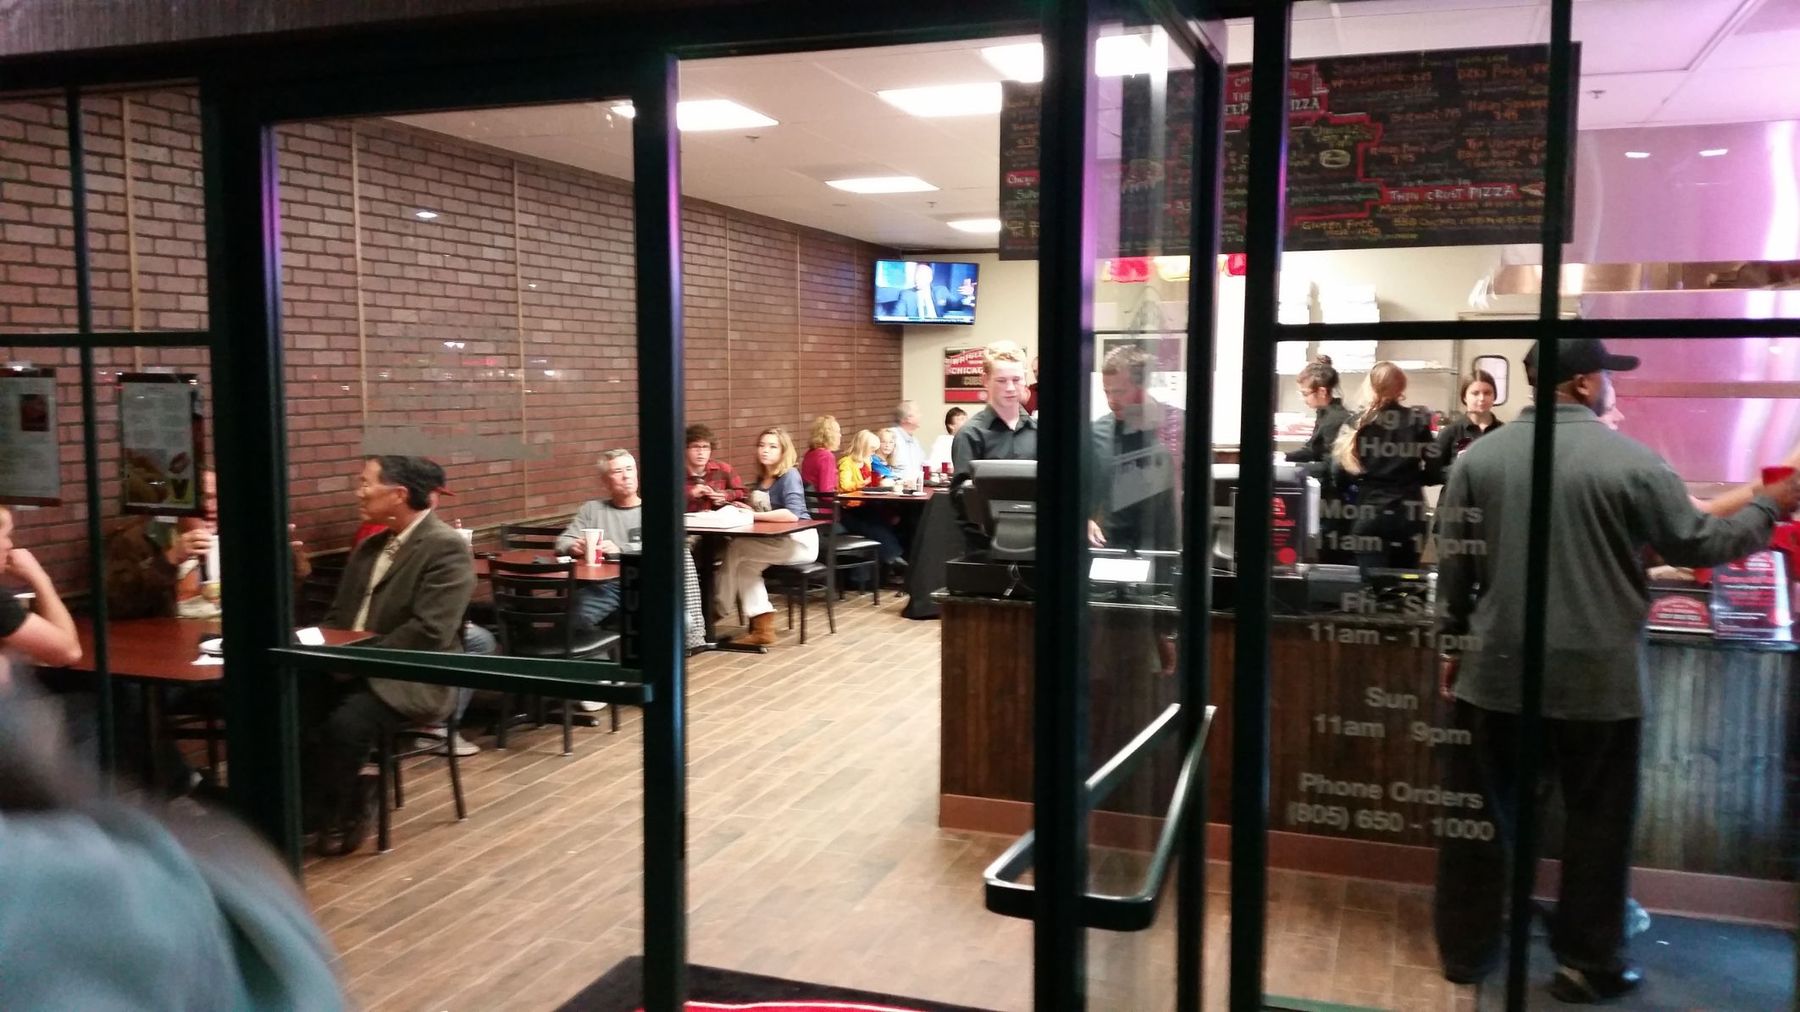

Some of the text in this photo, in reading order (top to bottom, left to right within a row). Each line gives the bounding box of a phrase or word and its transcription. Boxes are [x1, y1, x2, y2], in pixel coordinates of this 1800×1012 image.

[1468, 184, 1516, 199] PIZZA
[1360, 436, 1442, 458] Hours
[1319, 498, 1376, 520] Mon
[1308, 621, 1380, 645] 11am
[1408, 626, 1484, 654] 11pm
[1365, 686, 1419, 710] Sun
[1313, 713, 1472, 747] 11am 9pm
[1298, 772, 1484, 810] Phone Orders
[1354, 808, 1404, 833] 650
[1431, 816, 1496, 842] 1000
